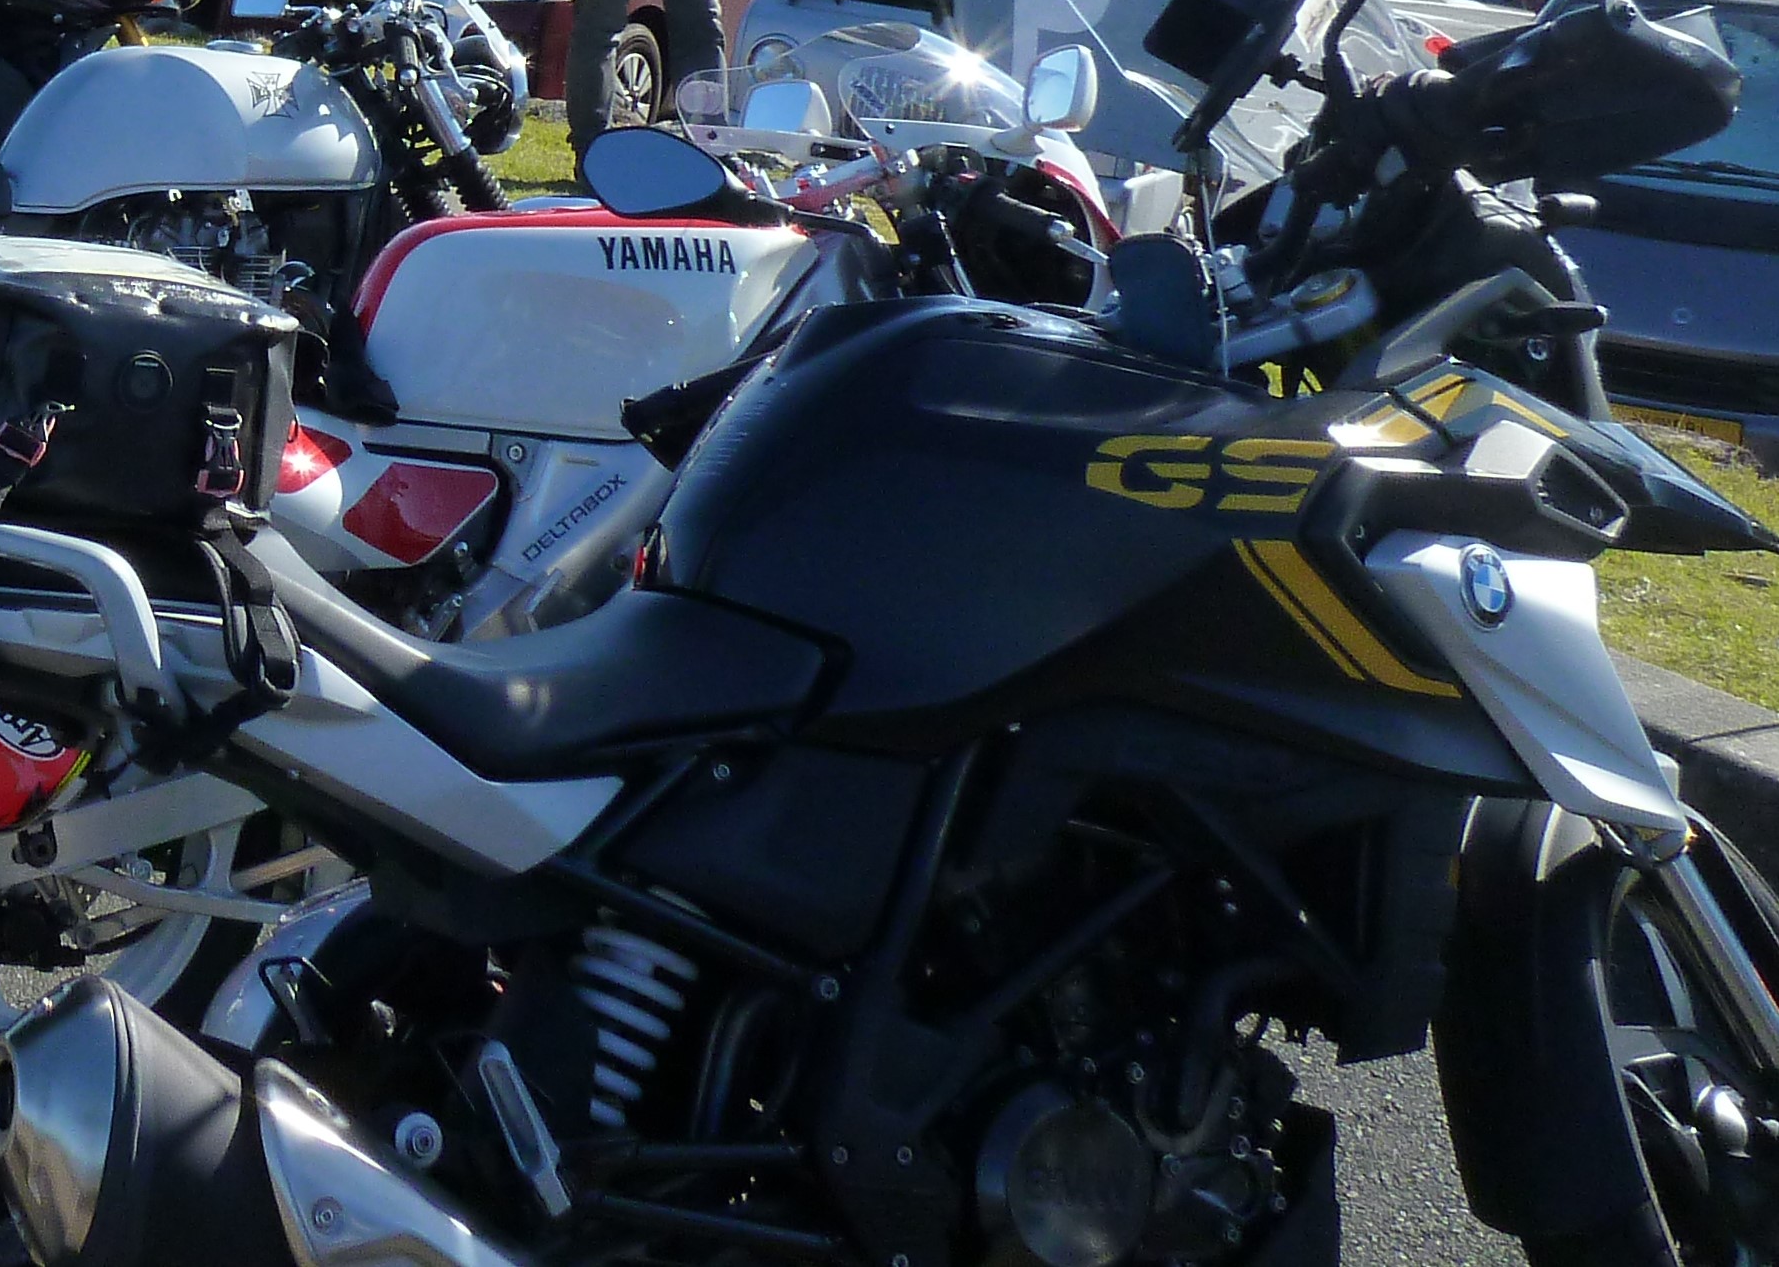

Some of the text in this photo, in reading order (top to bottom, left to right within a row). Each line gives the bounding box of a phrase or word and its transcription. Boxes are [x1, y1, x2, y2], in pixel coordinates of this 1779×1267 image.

[597, 236, 736, 275] YAMAHA
[1085, 434, 1337, 514] GS
[521, 474, 628, 562] DELTABOX
